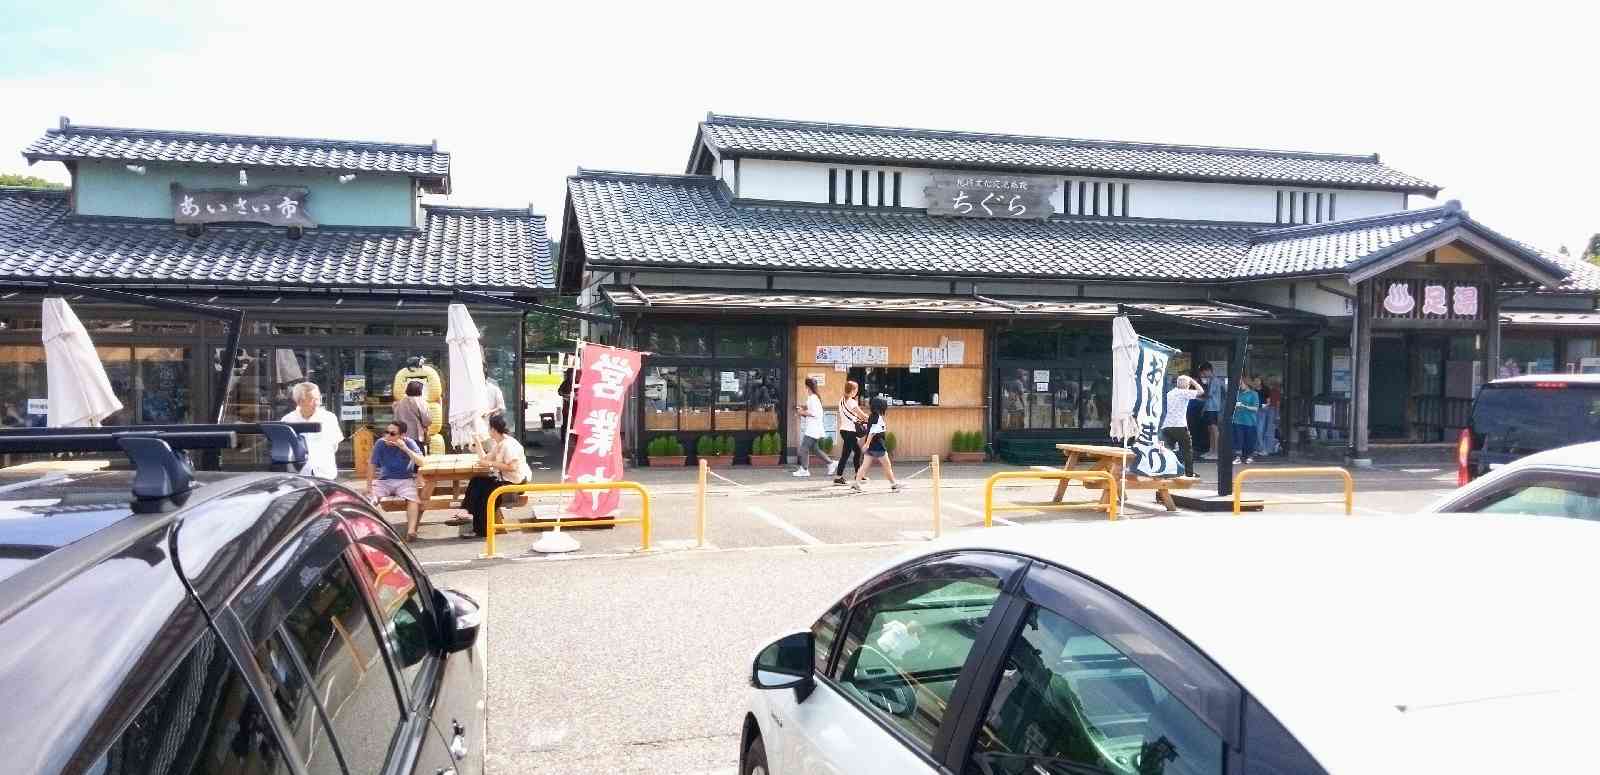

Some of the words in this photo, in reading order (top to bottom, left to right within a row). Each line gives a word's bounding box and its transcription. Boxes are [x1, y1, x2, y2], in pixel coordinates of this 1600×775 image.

[180, 194, 299, 218] あいさい市
[953, 190, 1027, 216] ちぐら
[1422, 285, 1478, 315] 足湯
[577, 352, 634, 513] 営業中
